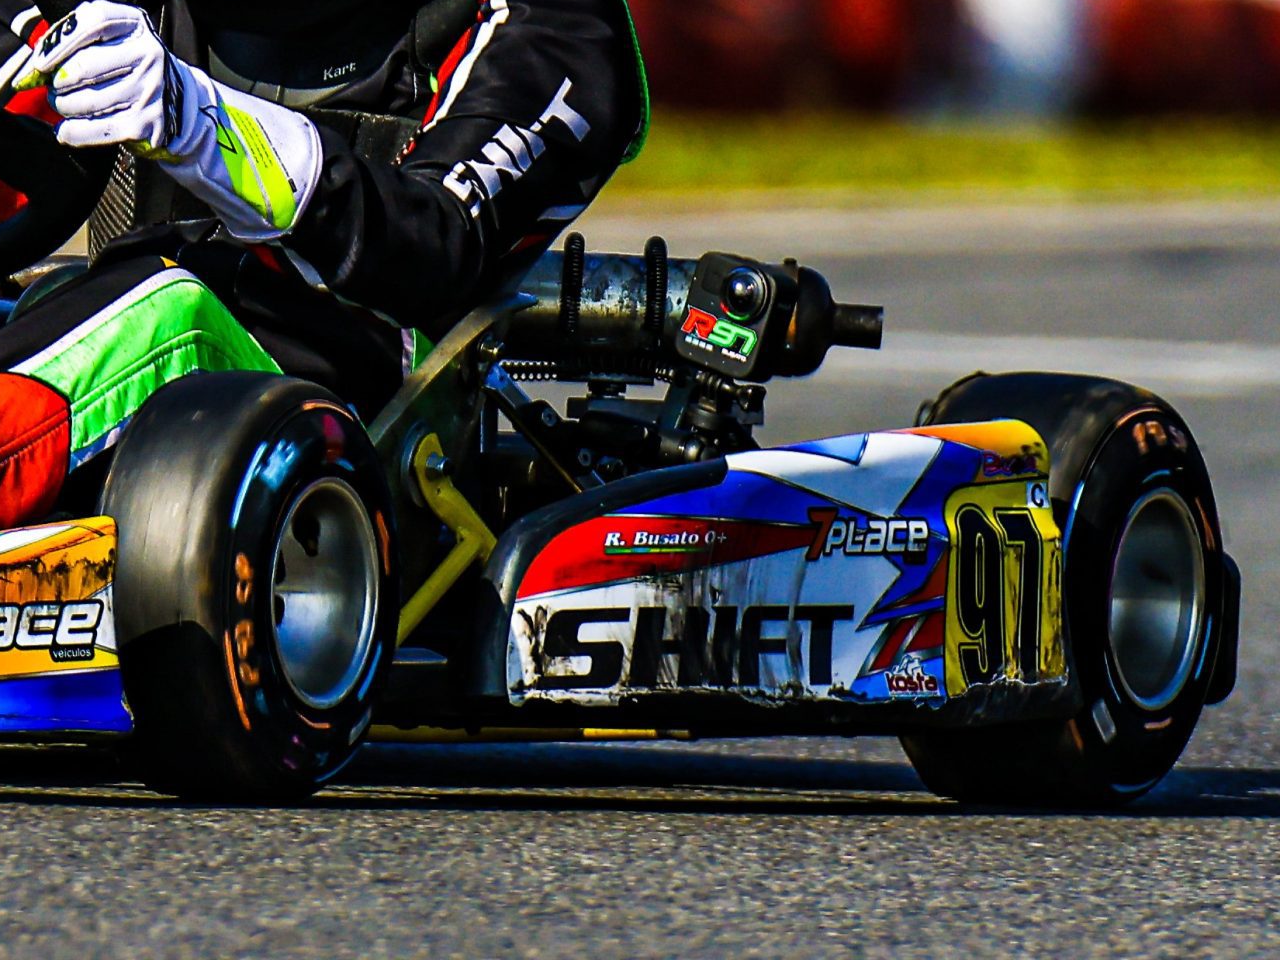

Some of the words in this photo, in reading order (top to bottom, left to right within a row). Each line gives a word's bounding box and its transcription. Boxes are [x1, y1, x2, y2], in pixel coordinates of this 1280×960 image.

[1031, 484, 1044, 508] C
[604, 531, 626, 547] R.
[633, 531, 699, 546] Busato
[956, 503, 1042, 685] 97
[538, 604, 855, 690] SHIFT
